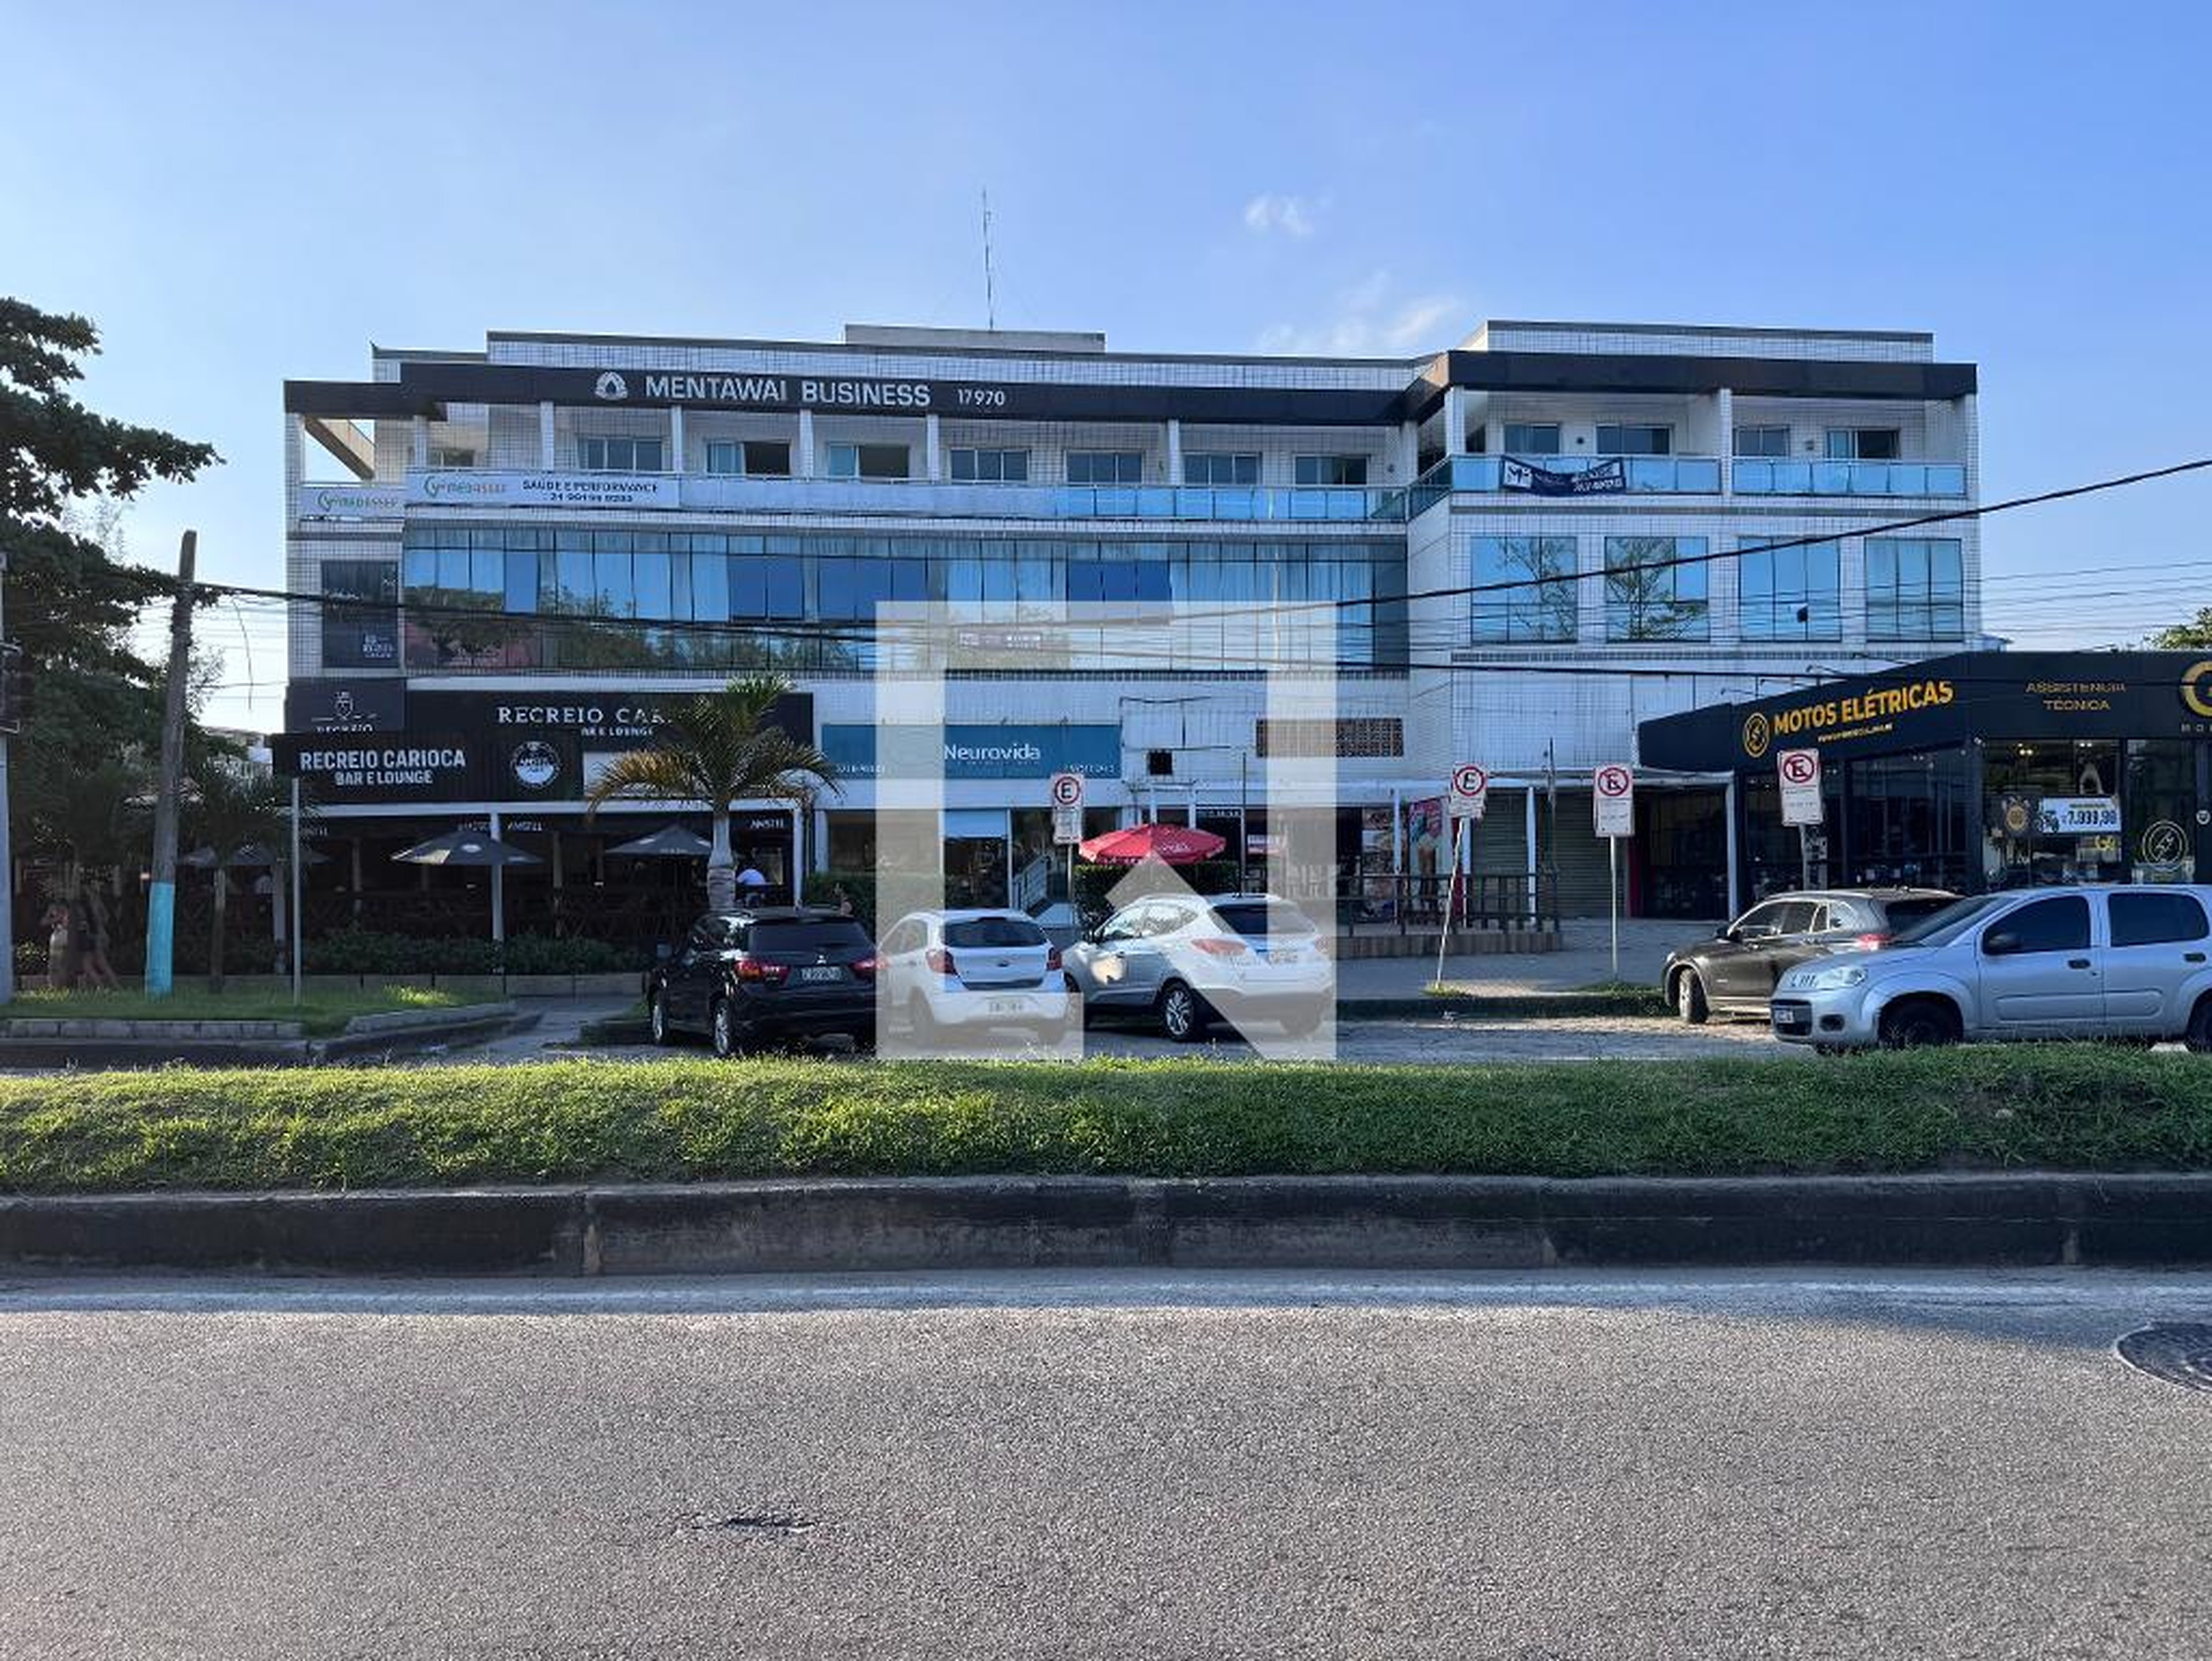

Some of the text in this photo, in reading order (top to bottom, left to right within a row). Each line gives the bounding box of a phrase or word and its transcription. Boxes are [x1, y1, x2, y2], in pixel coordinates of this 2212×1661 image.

[645, 375, 1006, 407] MENTAWAI BUSINESS 17970
[497, 707, 604, 724] RECREIO
[1774, 702, 1837, 735] MOTOS
[1842, 680, 1954, 722] ELÉTRICAS
[300, 749, 466, 770] RECREIO CARIOCA
[944, 743, 1041, 760] Neurovida
[335, 770, 433, 786] BAR E LOUNGE
[1061, 782, 1073, 799] E
